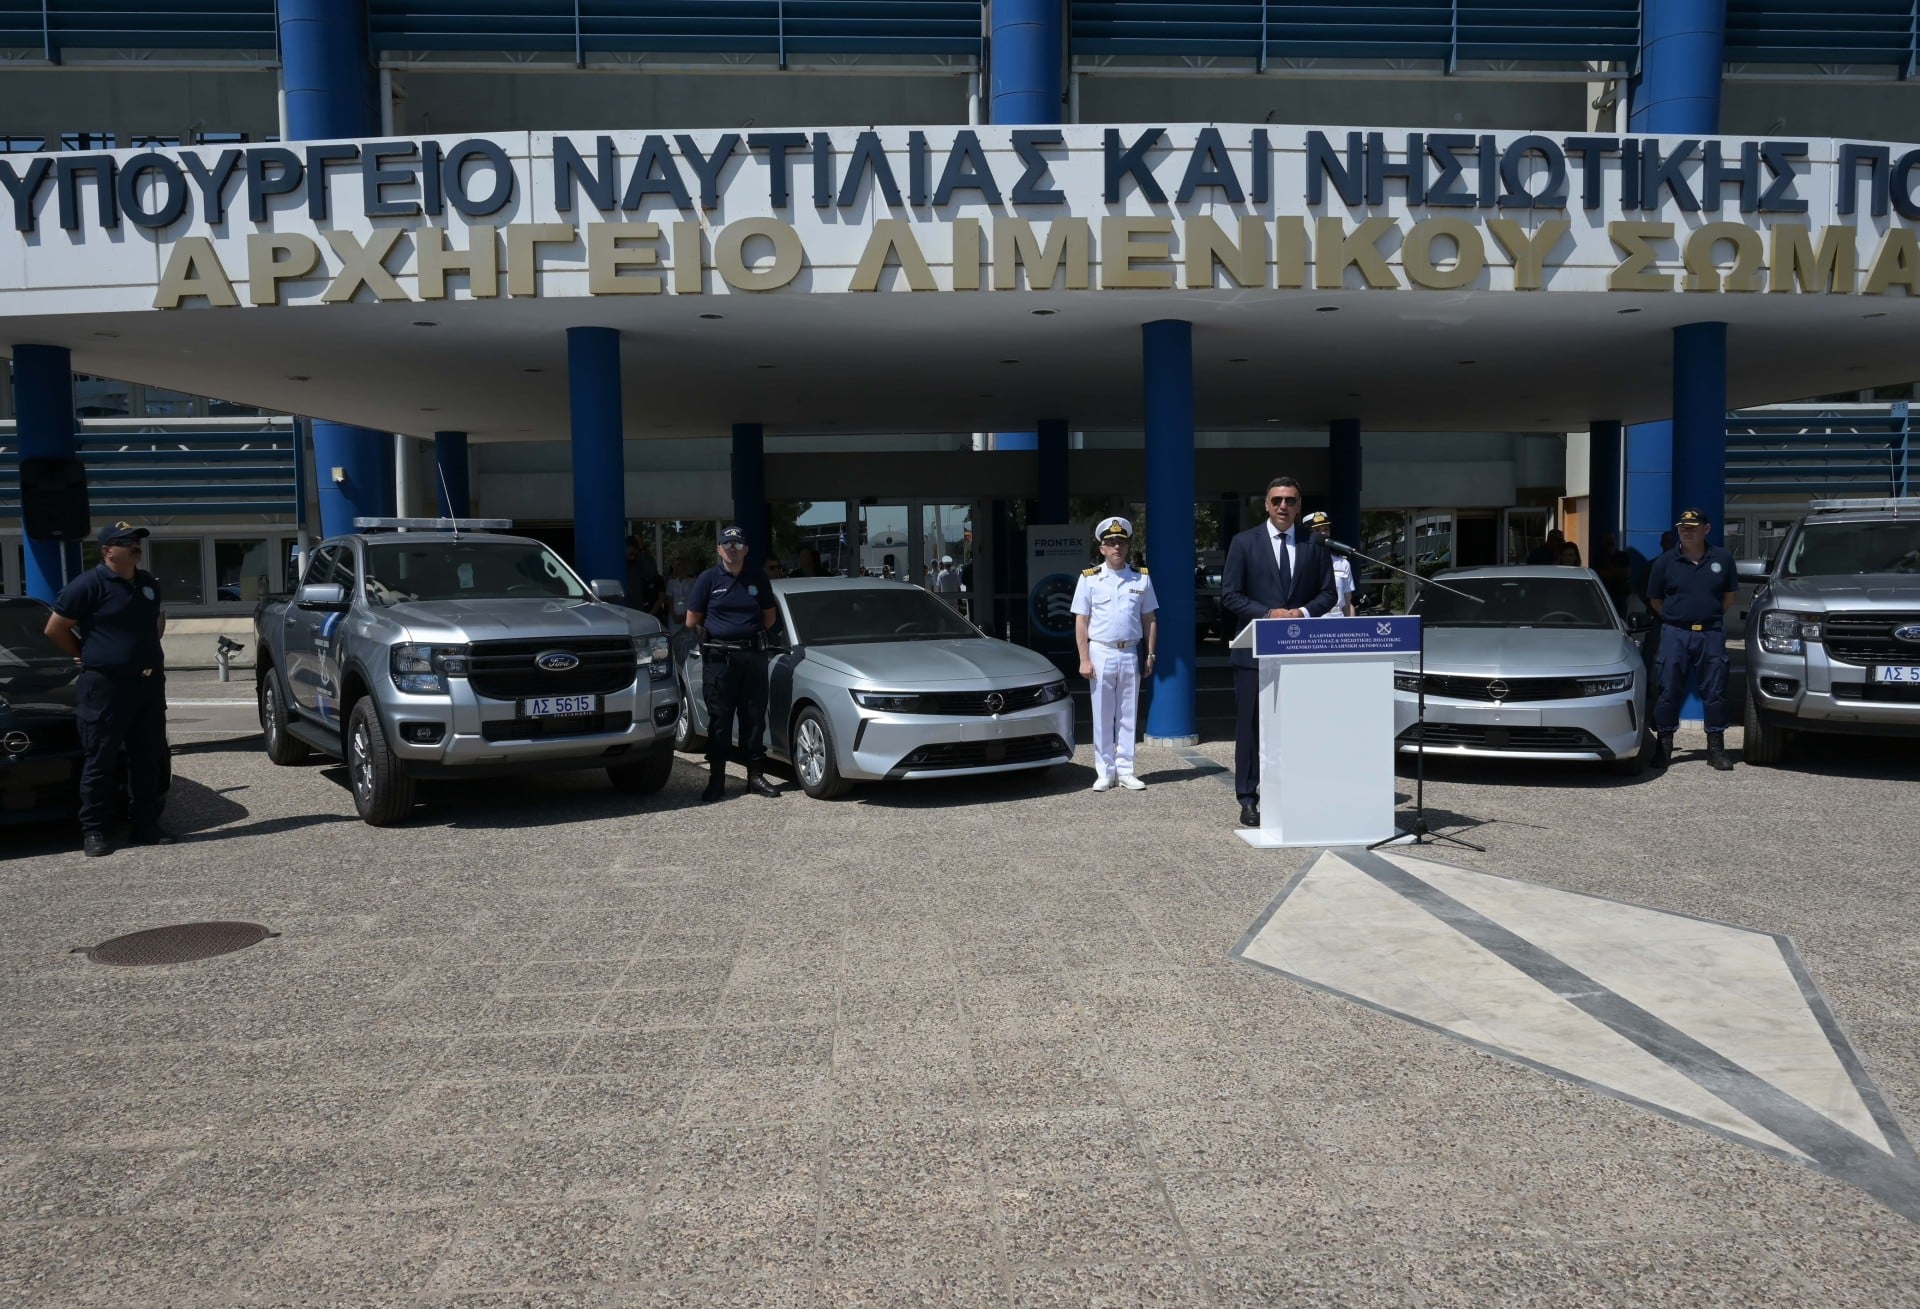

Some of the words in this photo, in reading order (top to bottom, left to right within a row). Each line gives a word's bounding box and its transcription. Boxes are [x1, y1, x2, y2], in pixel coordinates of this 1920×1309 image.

[0, 138, 515, 231] ΥΠΟΥΡΓΕΙΟ
[553, 129, 1064, 212] ΝΑΥΤΙΛΙΑΣ
[1104, 128, 1268, 204] ΚΑΙ
[1305, 130, 1809, 213] ΝΗΣΙΩΤΙΚΗΣ
[152, 216, 803, 310] ΑΡΧΗΓΕΙΟ
[848, 214, 1571, 293] ΛΙΜΕΝΙΚΟΥ
[1606, 219, 1920, 297] ΣΩΜΑ
[1035, 538, 1082, 547] FRONTEX
[1884, 667, 1903, 680] ΛΣ
[533, 699, 549, 714] ΛΣ
[556, 696, 589, 712] 5615
